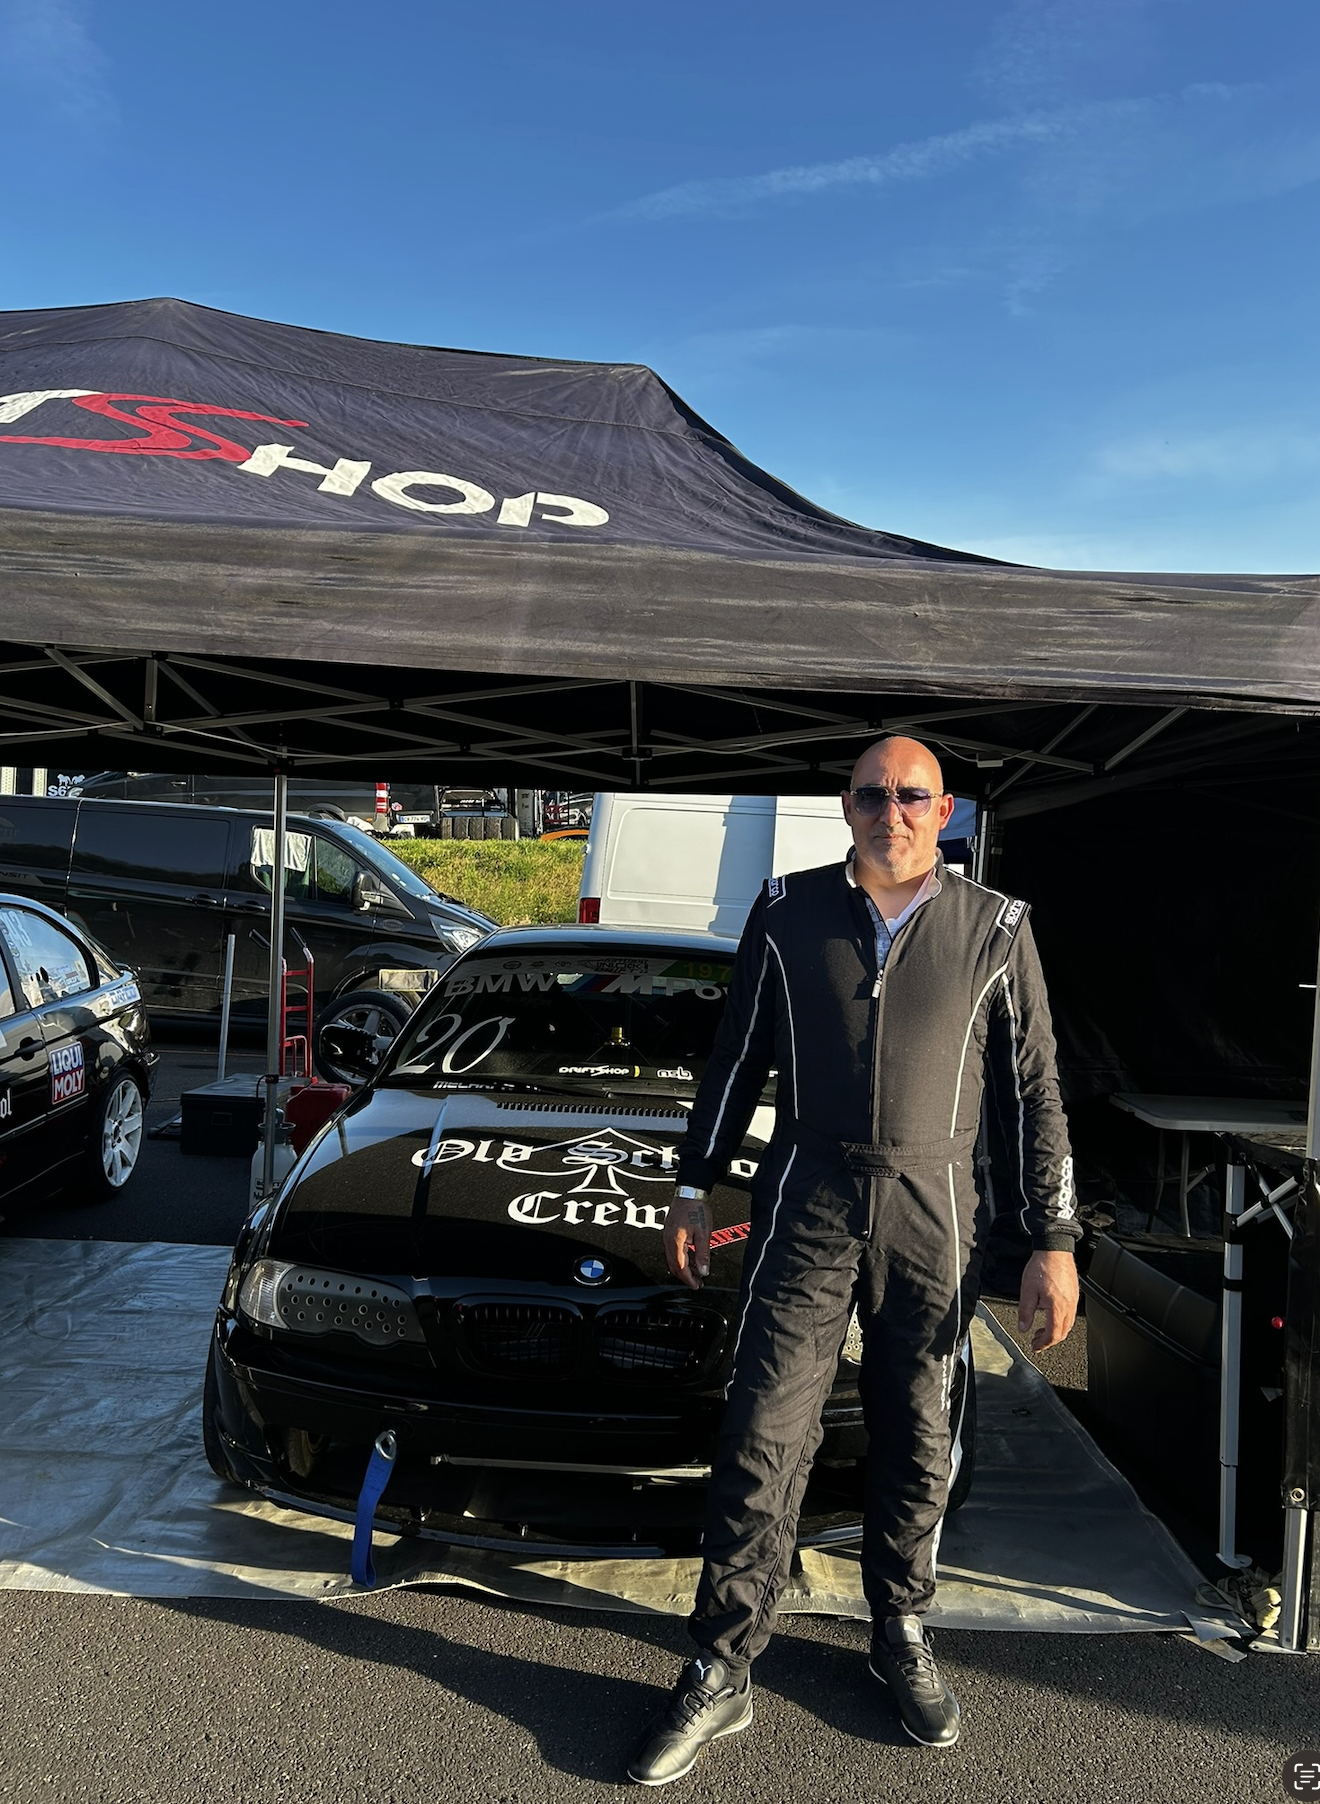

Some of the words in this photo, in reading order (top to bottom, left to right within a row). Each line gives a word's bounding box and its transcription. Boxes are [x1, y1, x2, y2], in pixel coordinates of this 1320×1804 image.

[443, 973, 557, 998] BMW
[600, 974, 653, 996] M
[665, 977, 729, 1001] Po
[388, 1012, 516, 1077] 20
[51, 1045, 83, 1076] LIQUI
[558, 1064, 630, 1077] DRIFTSHOP
[54, 1068, 84, 1101] MOLY
[410, 1138, 534, 1168] Old
[507, 1190, 670, 1231] Crew
